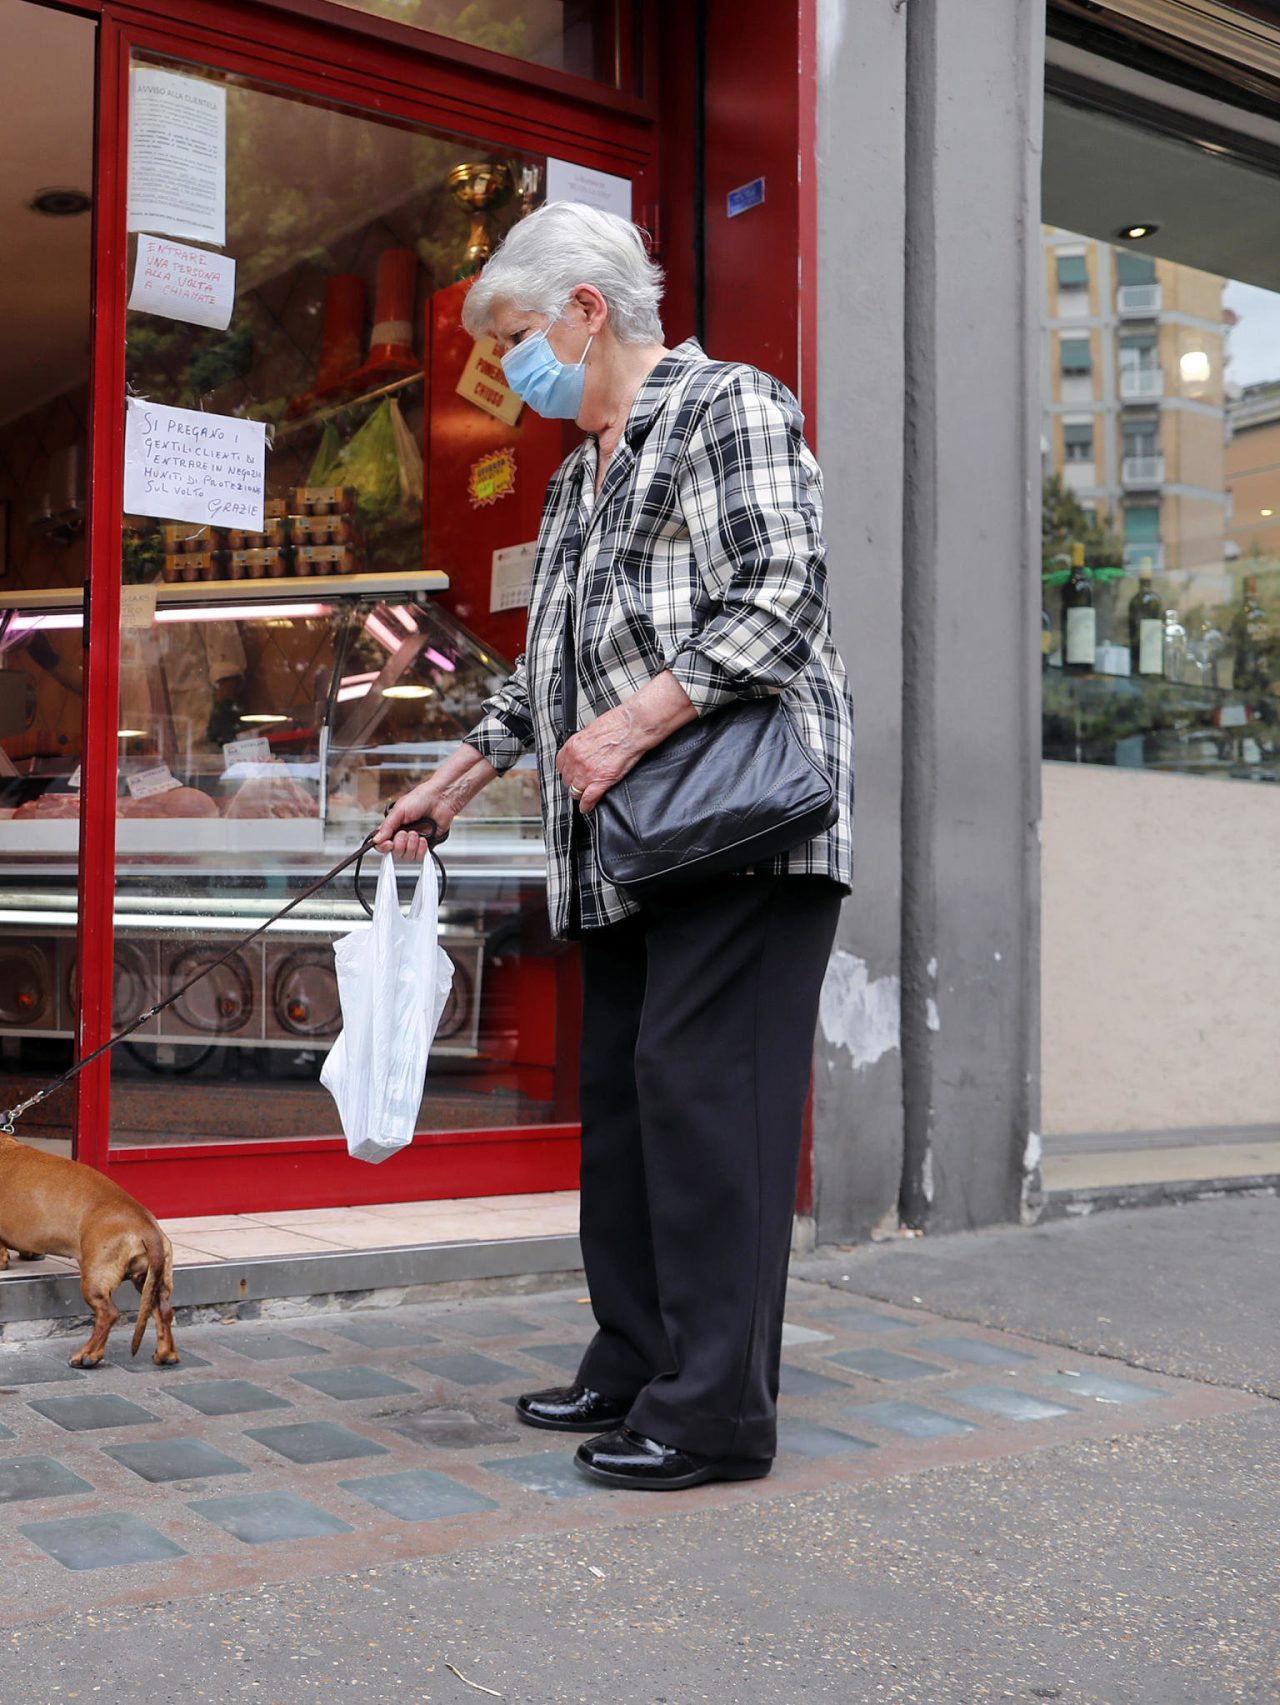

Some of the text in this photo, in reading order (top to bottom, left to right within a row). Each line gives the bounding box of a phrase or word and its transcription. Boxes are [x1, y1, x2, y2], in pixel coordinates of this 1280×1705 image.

[147, 242, 208, 265] ENTRARE
[145, 268, 171, 280] ALLA
[147, 256, 220, 281] UNA PERSONA
[142, 412, 158, 435] SI
[168, 420, 225, 442] PREGANO
[195, 447, 240, 461] CLIENTI
[154, 455, 208, 471] ENTRARE
[212, 464, 222, 472] IN
[144, 467, 182, 481] MUNITI
[145, 480, 204, 497] SUL VOLTO
[208, 499, 258, 518] GRAZIE
